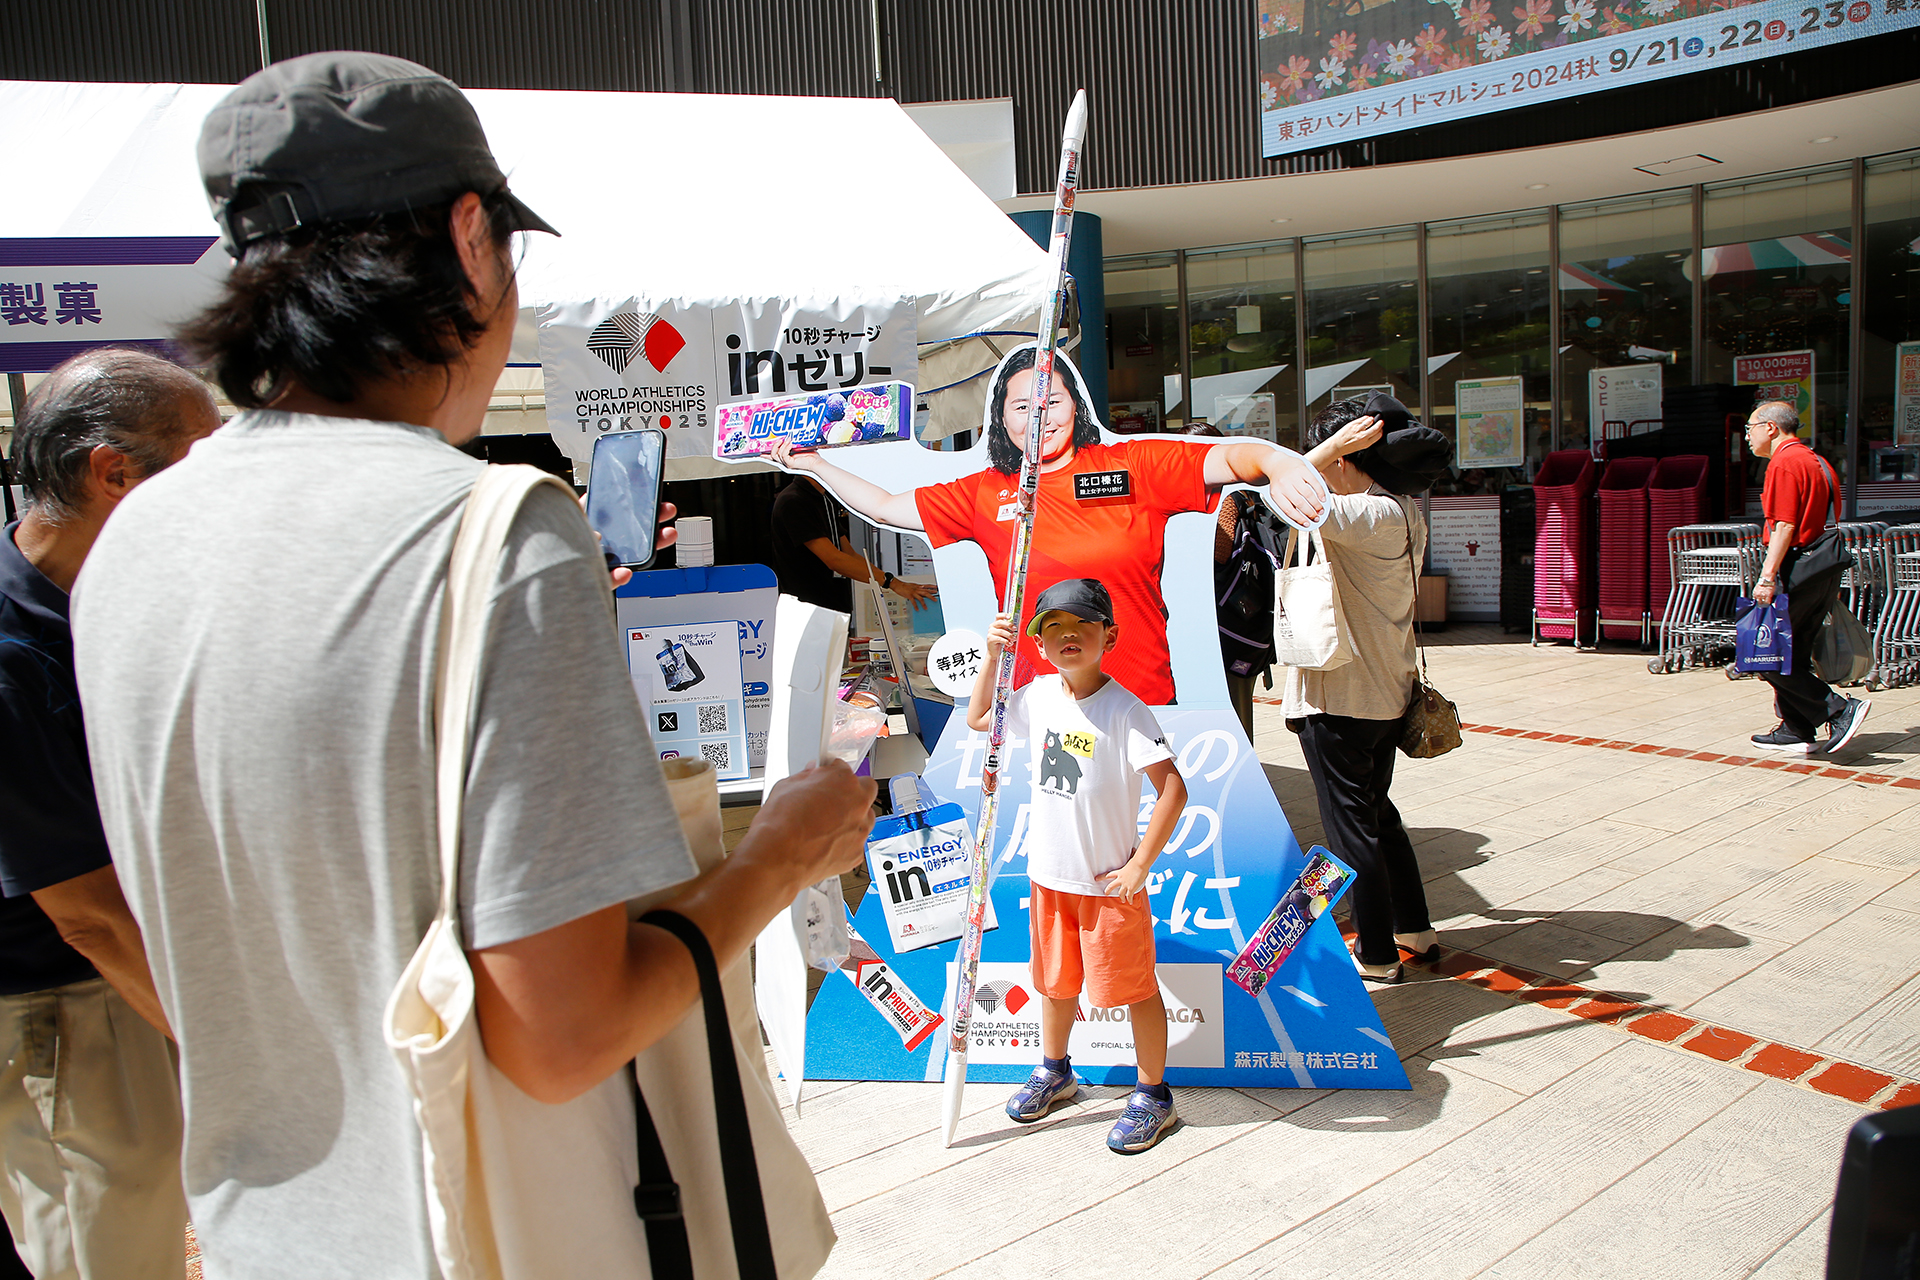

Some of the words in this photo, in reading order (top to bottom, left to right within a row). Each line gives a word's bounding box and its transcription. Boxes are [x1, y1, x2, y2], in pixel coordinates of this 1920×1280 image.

[783, 325, 882, 346] 10秒チャージ
[1904, 356, 1920, 367] 新
[575, 387, 628, 402] WORLD
[632, 385, 705, 398] ATHLETICS
[576, 399, 706, 417] CHAMPIONSHIPS
[697, 638, 713, 646] Win
[936, 647, 982, 672] 等身大
[948, 664, 979, 682] サイズ
[1063, 733, 1093, 753] みなと
[897, 837, 963, 863] ENERGY
[922, 850, 969, 873] 10秒チャージ
[883, 860, 932, 904] in
[864, 965, 893, 1001] in
[882, 999, 896, 1013] BAR
[887, 991, 921, 1027] PROTEIN
[970, 1030, 1040, 1039] HAMPIONSHIPS
[971, 1022, 994, 1030] ORLD
[996, 1022, 1040, 1030] ATHLETICS
[1234, 1051, 1379, 1069] 森永製菓株式会社
